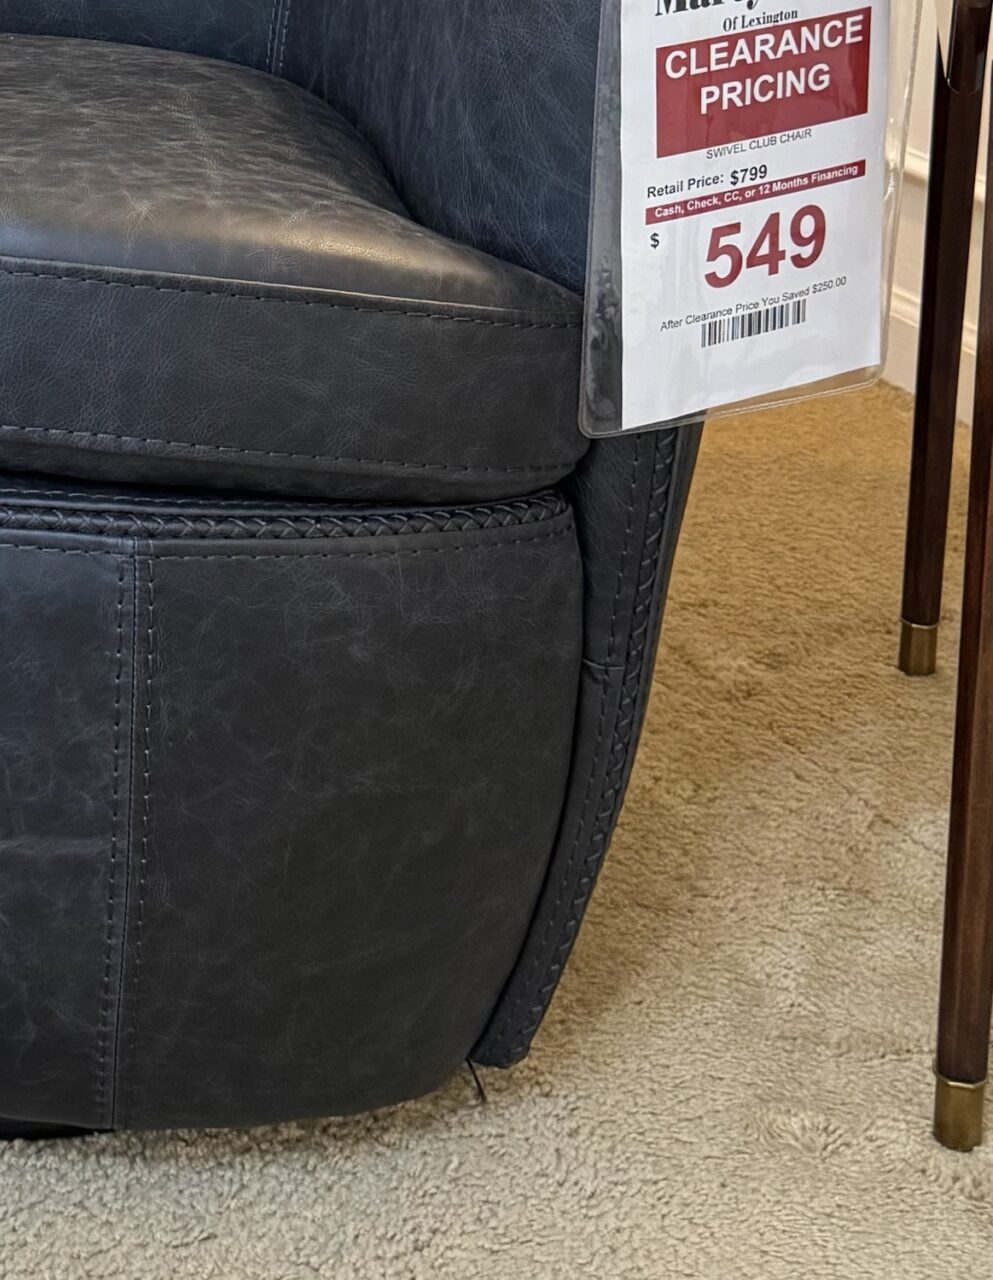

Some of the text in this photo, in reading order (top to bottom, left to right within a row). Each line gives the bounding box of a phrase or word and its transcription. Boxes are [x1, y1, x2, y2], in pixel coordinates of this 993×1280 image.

[664, 14, 864, 79] CLEARANCE
[723, 10, 798, 32] Of Lexington
[700, 63, 830, 114] PRICING
[706, 128, 812, 159] SWIVEL CLUB CHAIR
[647, 164, 768, 198] Retail Price: $799
[654, 165, 859, 217] Cash, Check, CC, or 12 Months Financing
[650, 204, 827, 289] $ 549
[660, 276, 847, 331] After Clearance Price You Saved $250.00
